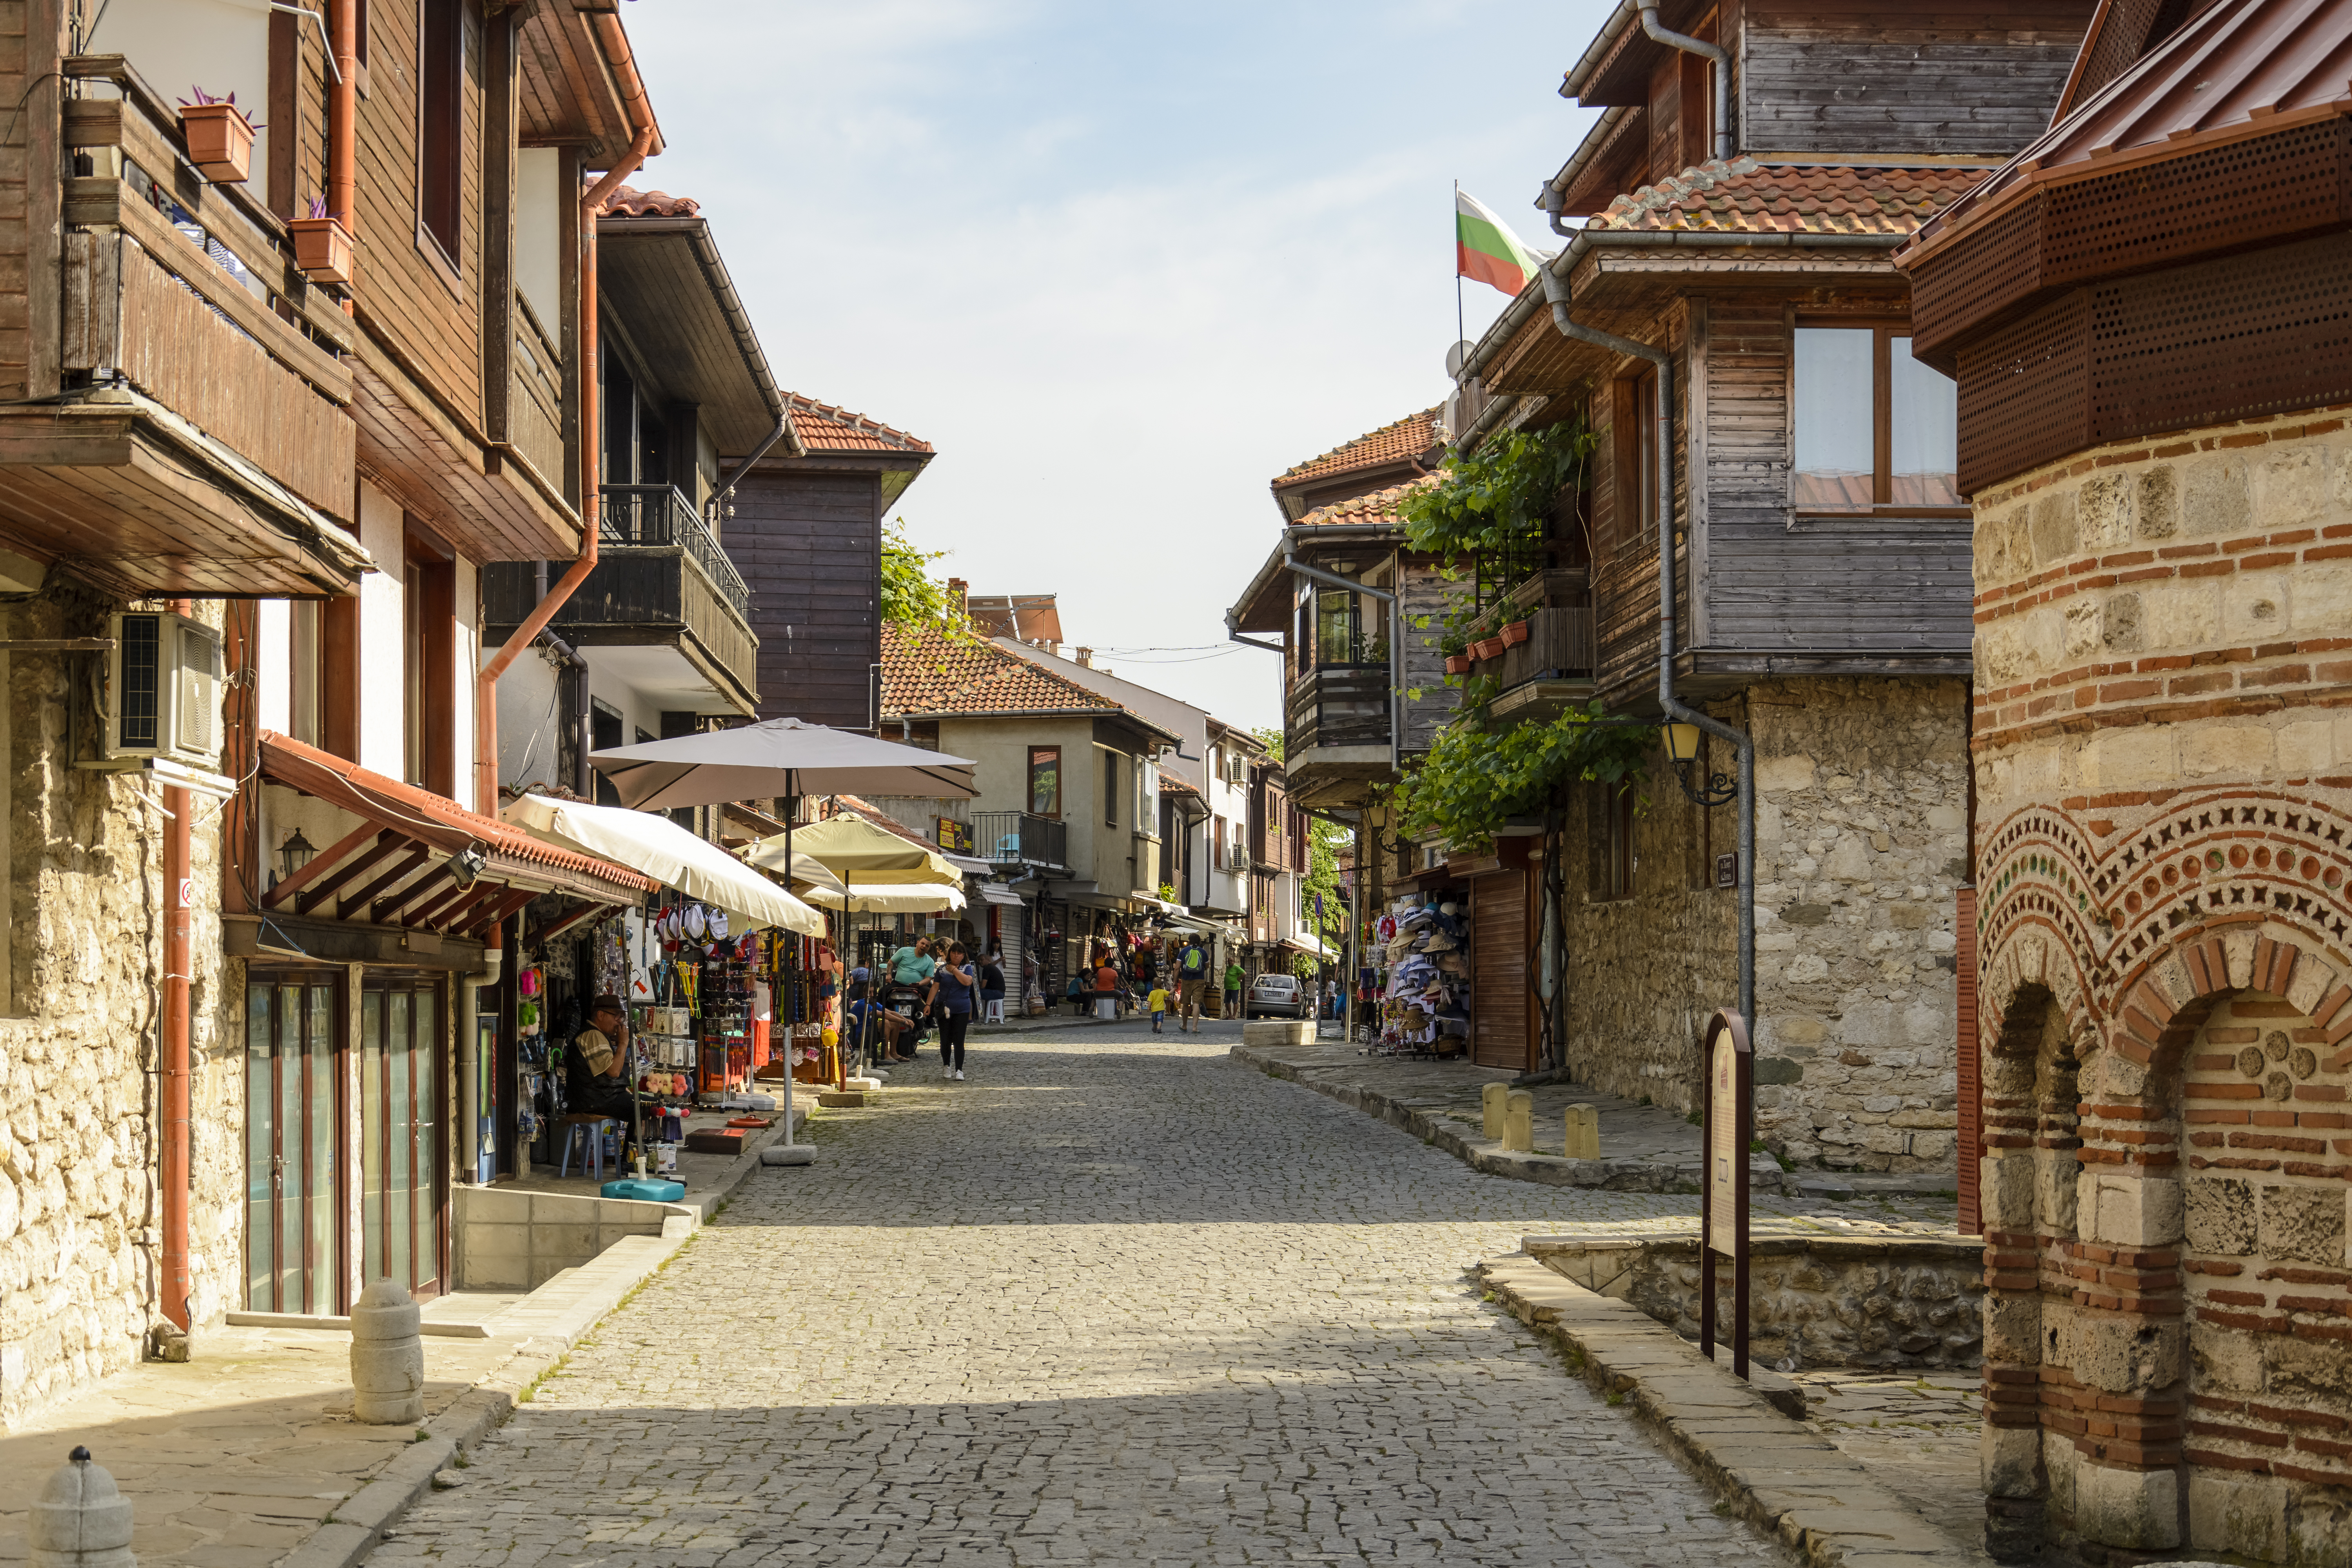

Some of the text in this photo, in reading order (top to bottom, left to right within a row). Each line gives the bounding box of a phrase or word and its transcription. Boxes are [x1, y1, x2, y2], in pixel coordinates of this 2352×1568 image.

[941, 820, 952, 831] COFFEE
[942, 834, 953, 845] TOBACCO
[964, 840, 972, 849] DRINKS
